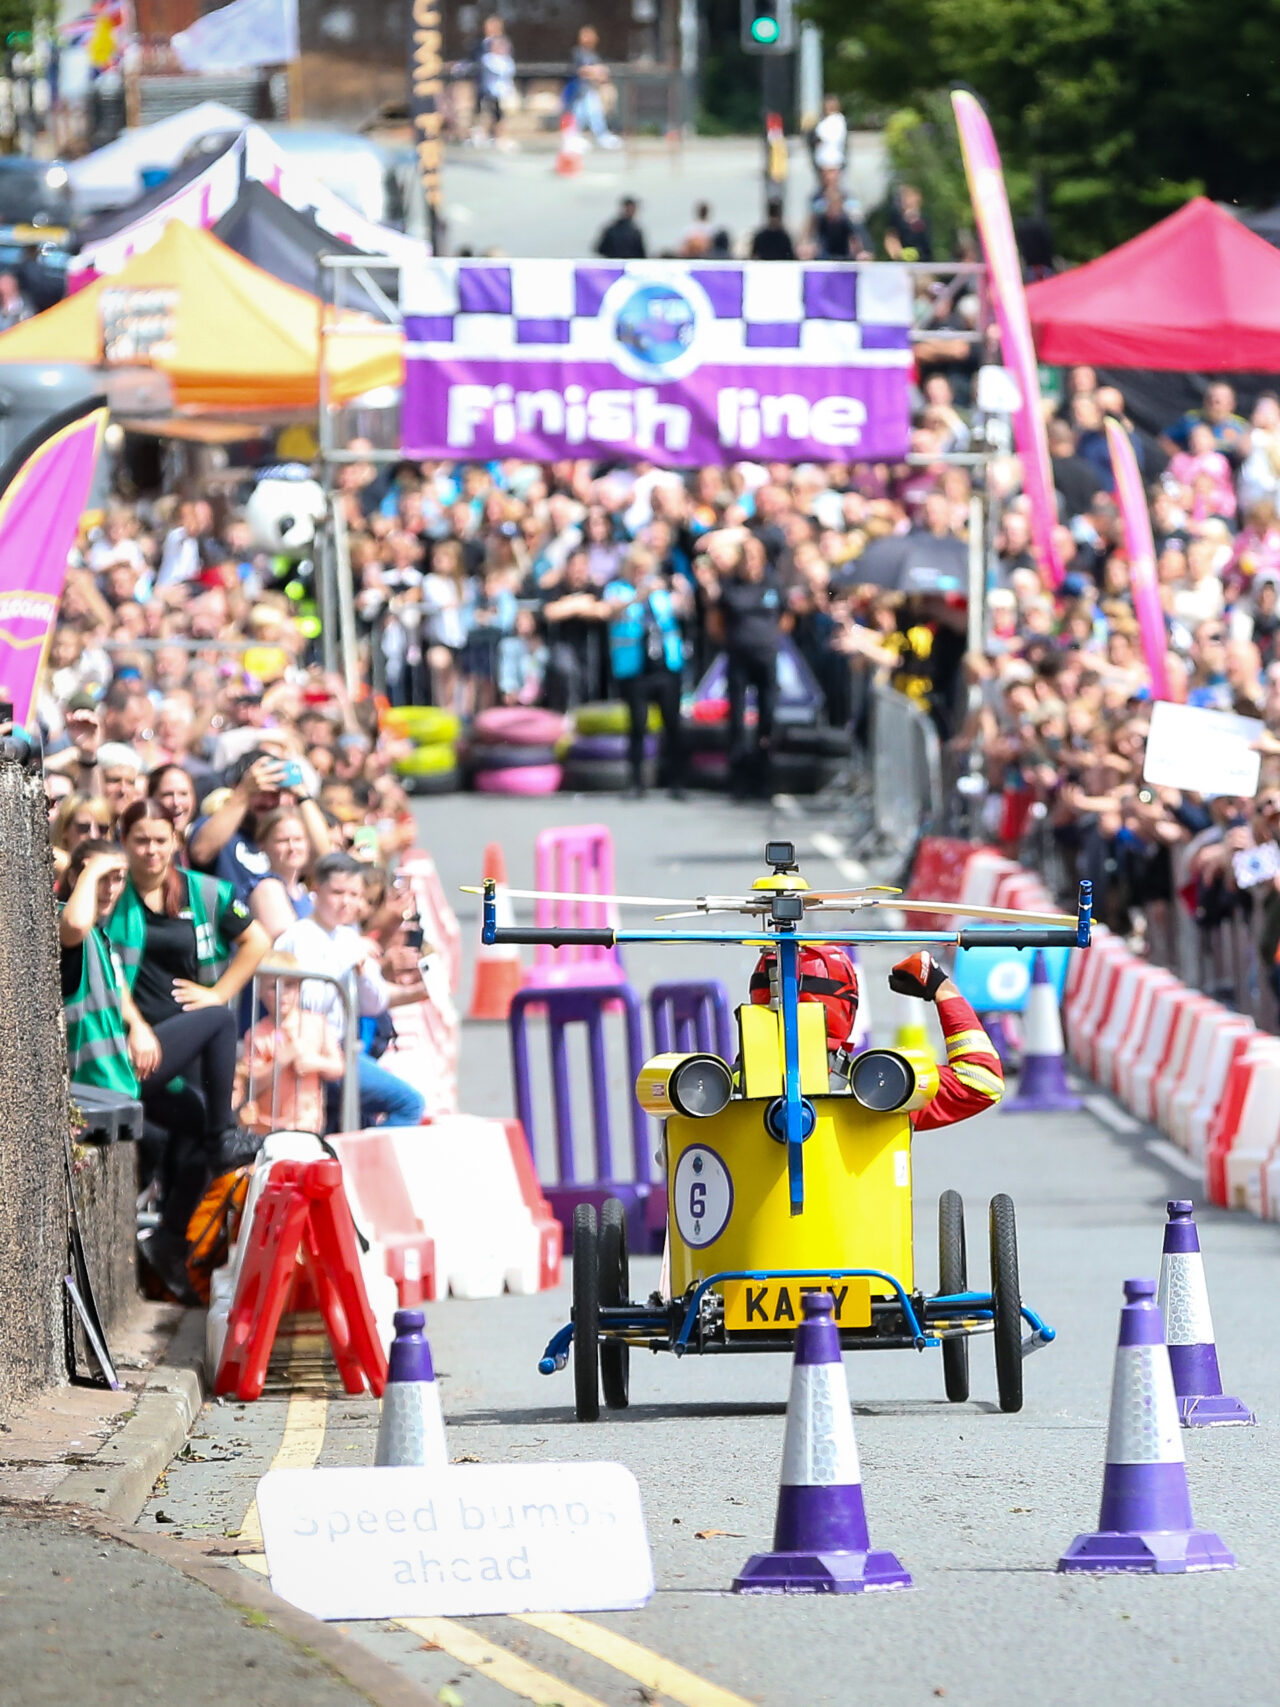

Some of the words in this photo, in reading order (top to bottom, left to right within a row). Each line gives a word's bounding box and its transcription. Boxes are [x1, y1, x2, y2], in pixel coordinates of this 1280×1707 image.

[447, 383, 692, 452] Finish
[717, 387, 867, 448] line
[690, 1182, 707, 1219] 6
[393, 1546, 532, 1585] ahead
